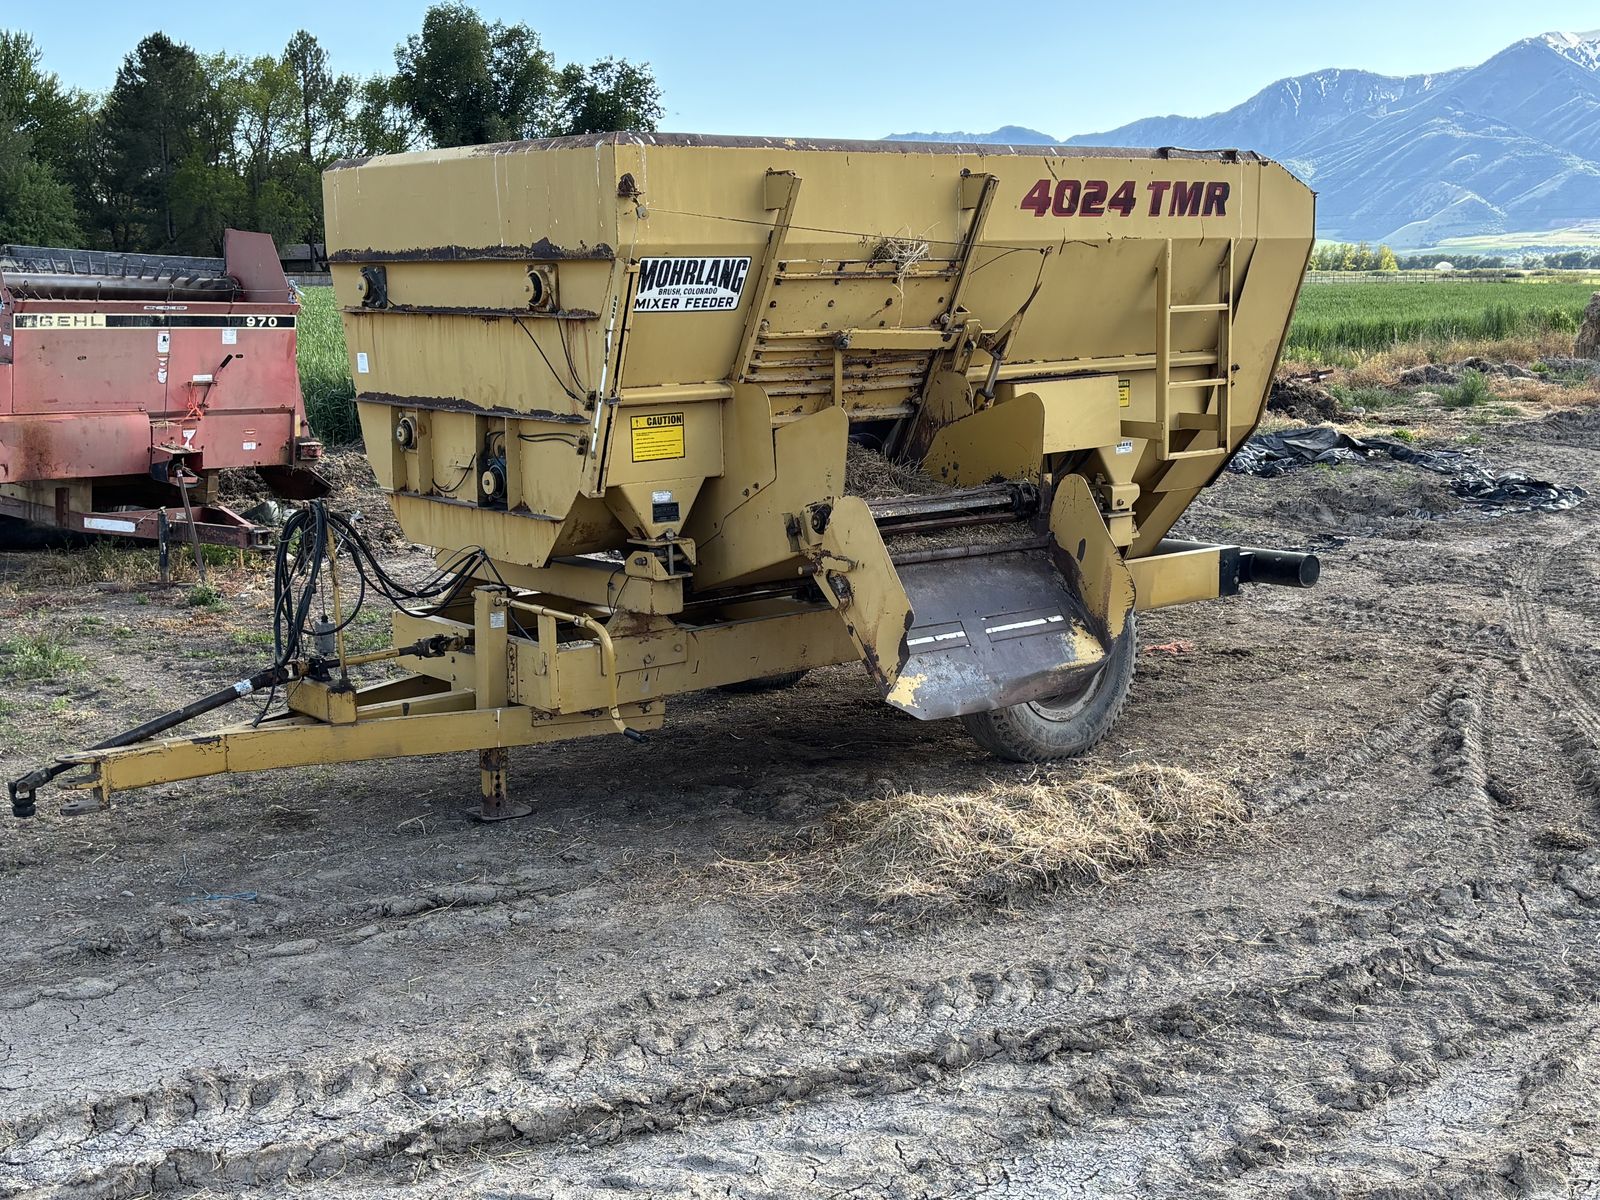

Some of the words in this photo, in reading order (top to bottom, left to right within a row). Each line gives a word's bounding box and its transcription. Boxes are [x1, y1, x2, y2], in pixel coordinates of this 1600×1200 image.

[1020, 179, 1136, 217] 4024
[1147, 181, 1231, 217] TMR
[639, 259, 748, 295] MOHRLANG
[658, 288, 682, 296] BRUSH,
[683, 287, 718, 295] COLORADO
[634, 298, 680, 309] MIXER
[685, 297, 734, 308] FEEDER
[40, 315, 104, 327] GEHL
[246, 316, 278, 327] 970
[646, 415, 682, 426] CAUTION
